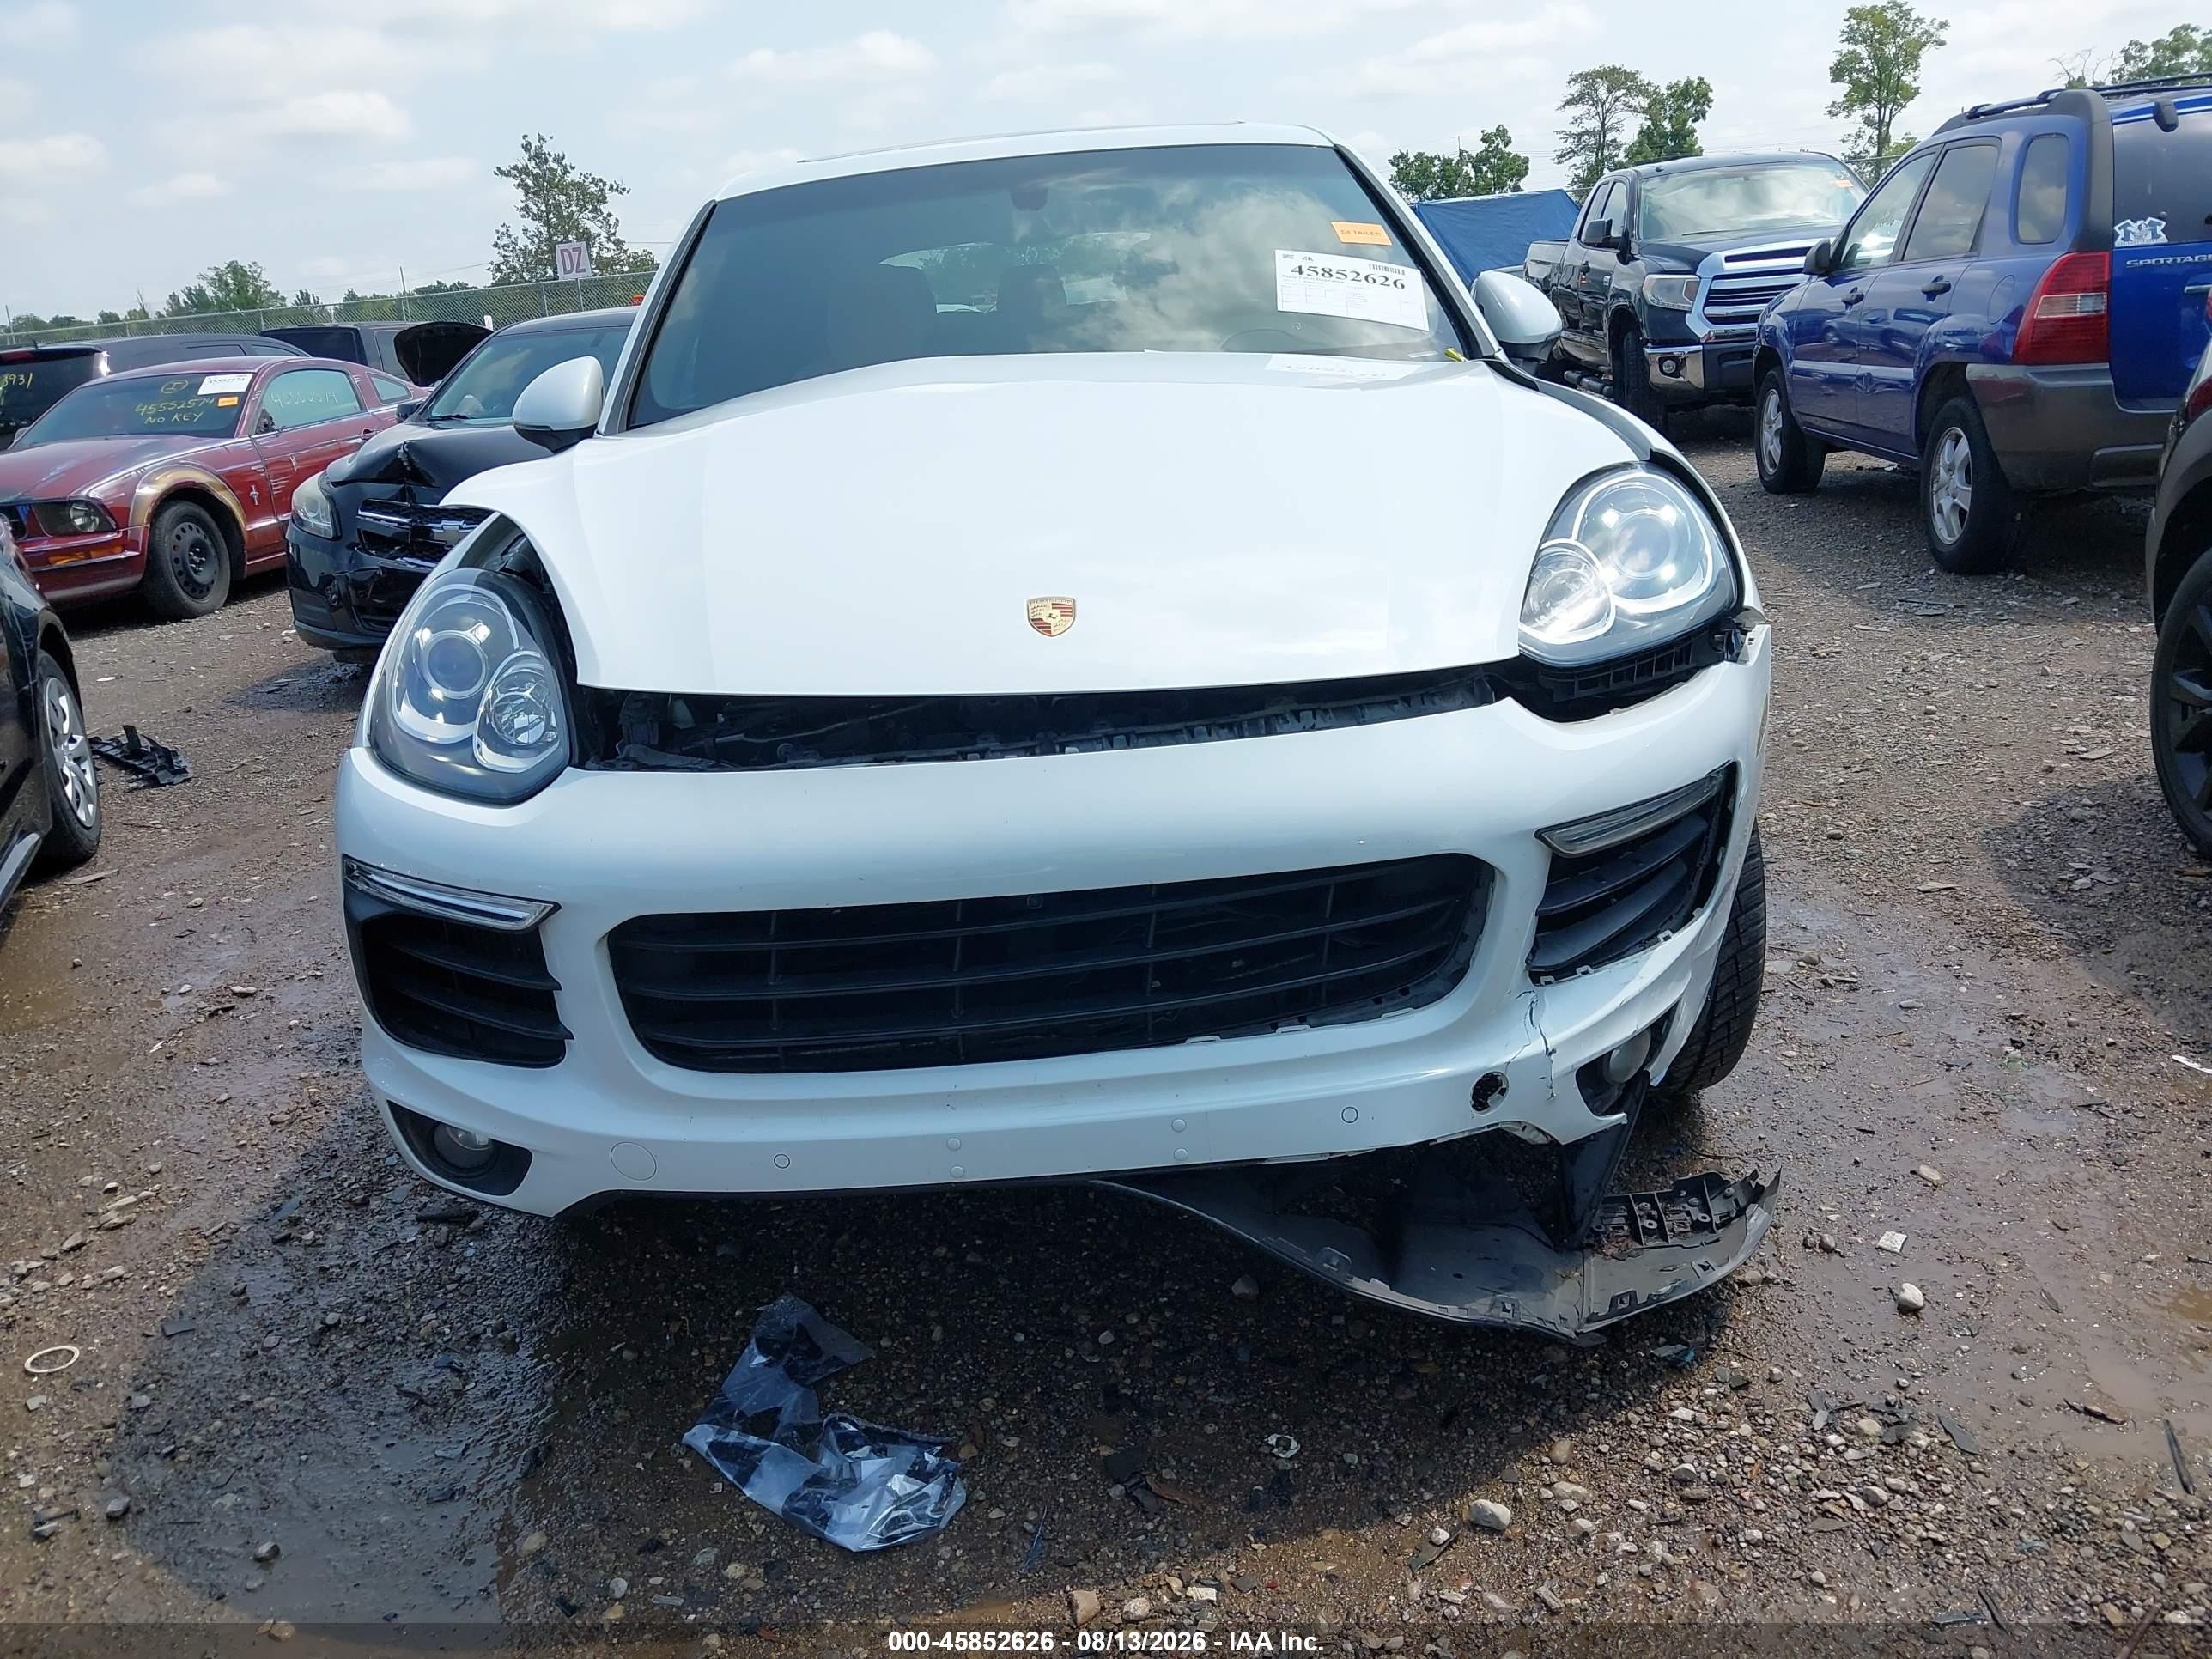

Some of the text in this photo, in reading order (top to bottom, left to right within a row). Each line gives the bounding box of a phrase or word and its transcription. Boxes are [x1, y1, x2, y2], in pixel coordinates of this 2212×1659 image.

[560, 246, 586, 275] DZ
[1291, 264, 1406, 289] 45852626
[135, 397, 215, 416] 45552574
[172, 412, 204, 423] KEY
